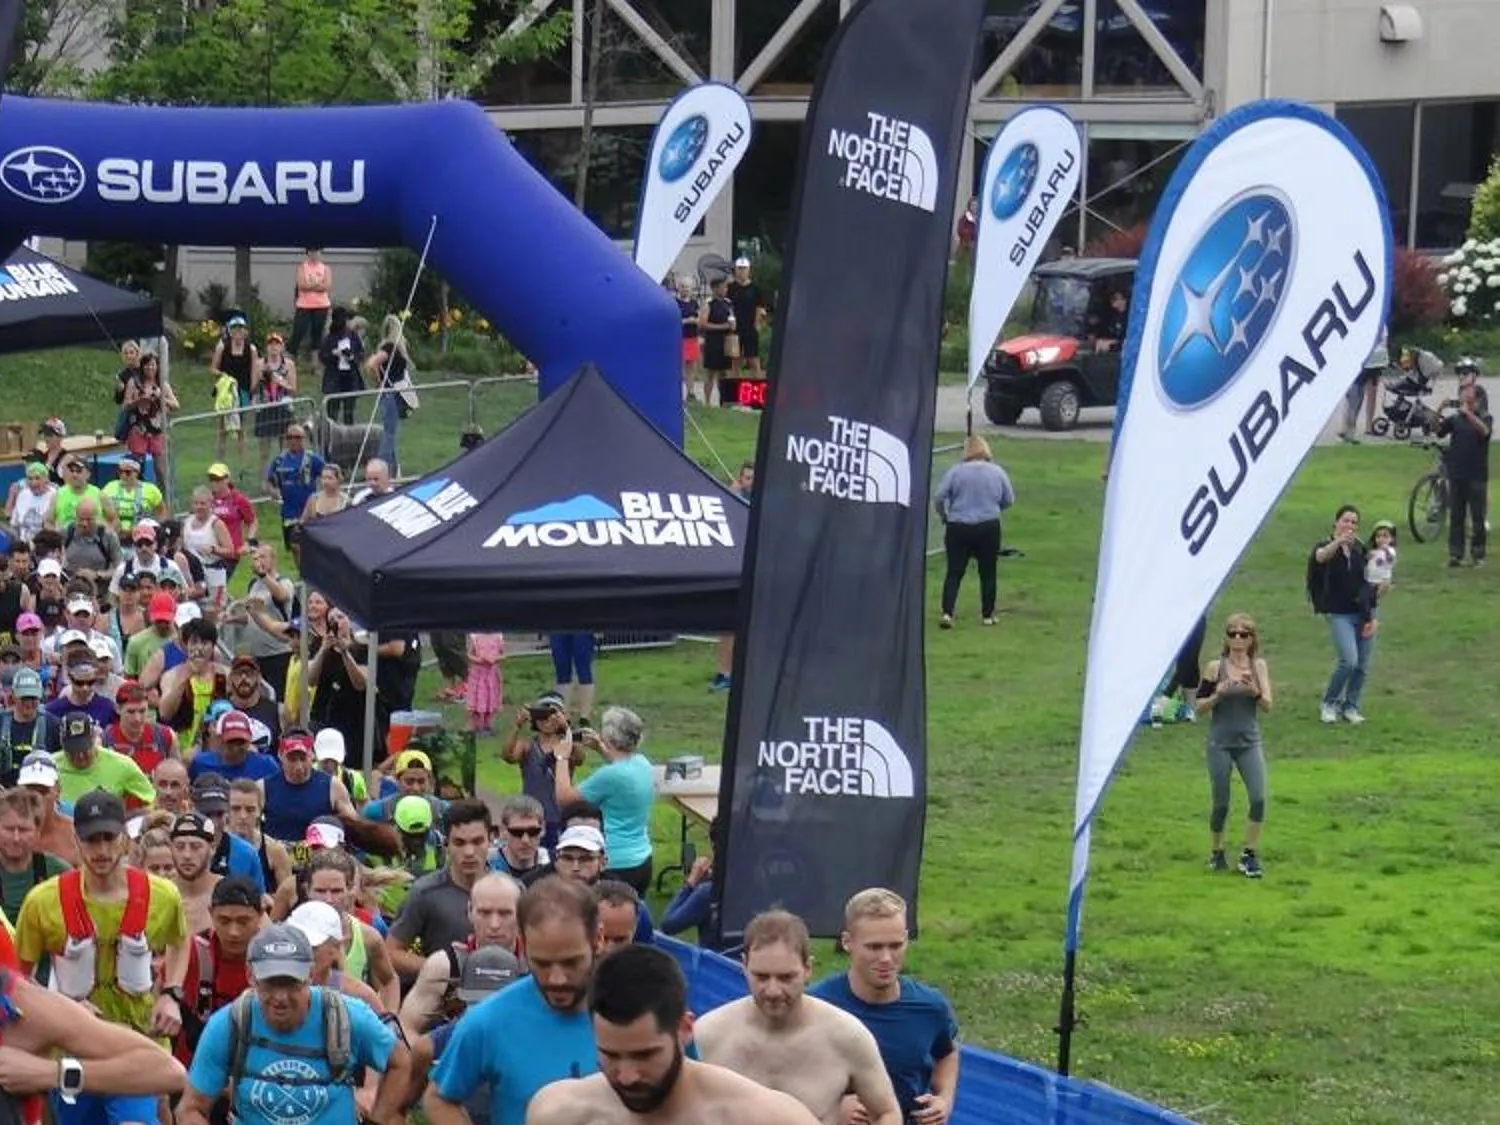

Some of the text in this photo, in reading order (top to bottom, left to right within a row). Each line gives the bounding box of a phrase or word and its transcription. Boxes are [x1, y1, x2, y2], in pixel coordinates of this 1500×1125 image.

[867, 111, 909, 149] THE
[827, 128, 905, 174] NORTH
[97, 158, 365, 205] SUBARU
[673, 121, 745, 223] SUBARU
[845, 161, 901, 200] FACE
[1008, 150, 1076, 268] SUBARU
[5, 262, 64, 284] BLUE
[1179, 249, 1378, 557] SUBARU
[827, 415, 868, 449] THE
[786, 434, 866, 475] NORTH
[808, 466, 865, 501] FACE
[619, 490, 728, 522] BLUE
[481, 517, 736, 547] MOUNTAIN
[802, 716, 862, 743] THE
[757, 740, 861, 769] NORTH
[784, 767, 861, 796] FACE
